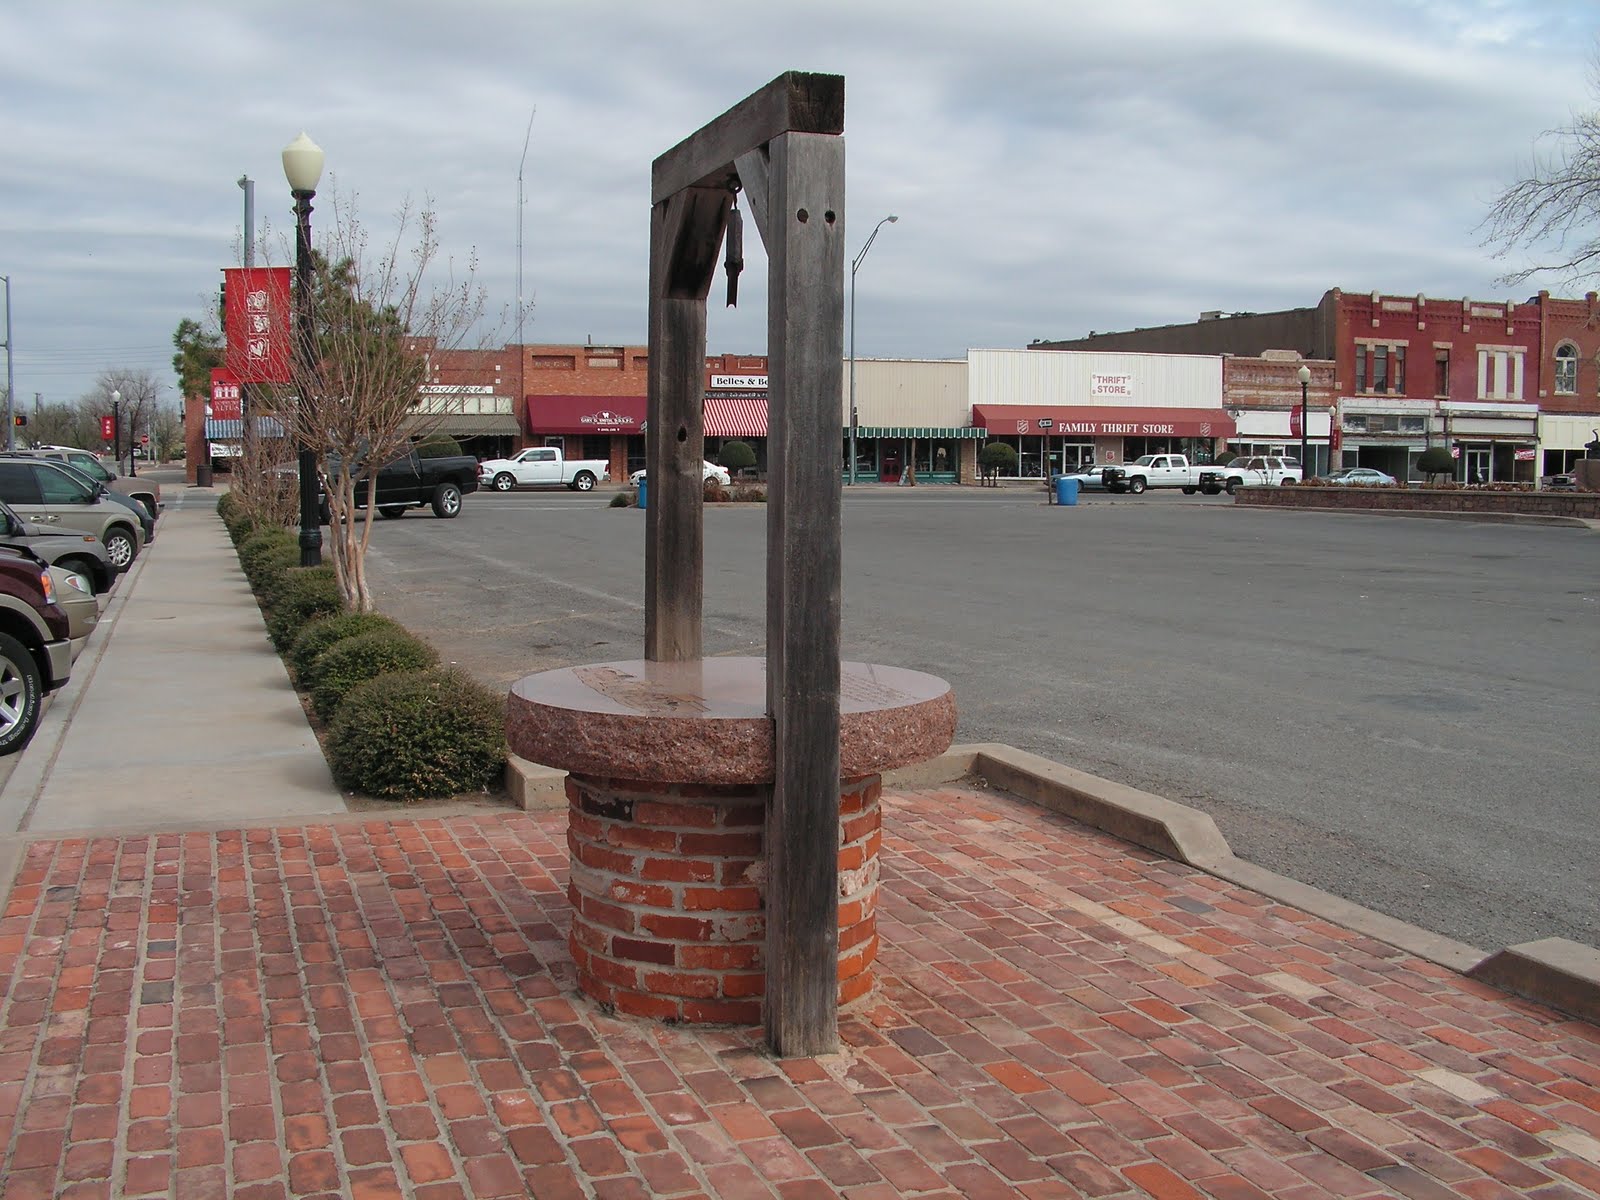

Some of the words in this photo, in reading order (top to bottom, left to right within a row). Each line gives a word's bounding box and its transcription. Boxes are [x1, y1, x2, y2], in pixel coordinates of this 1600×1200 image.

[716, 377, 744, 385] Belles
[1097, 376, 1127, 384] THRIFT
[1097, 386, 1126, 394] STORE
[1059, 422, 1097, 433] FAMILY
[1101, 423, 1139, 433] THRIFT
[1143, 424, 1175, 434] STORE
